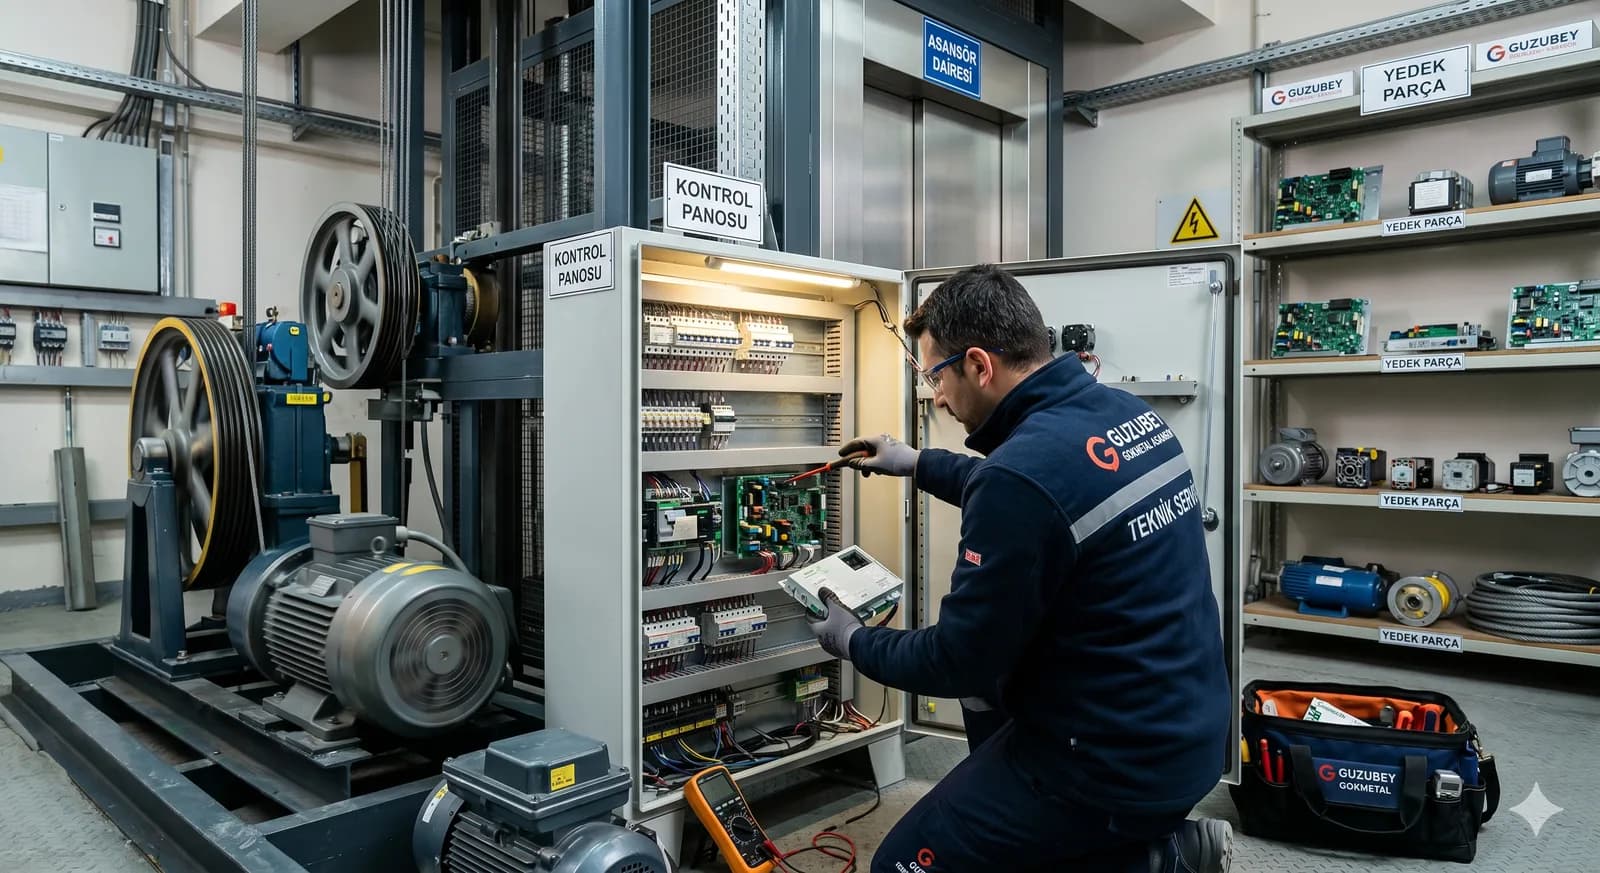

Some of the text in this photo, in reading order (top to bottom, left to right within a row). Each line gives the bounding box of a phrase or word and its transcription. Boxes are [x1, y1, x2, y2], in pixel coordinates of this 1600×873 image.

[928, 34, 977, 66] ASANSÖR
[1508, 29, 1580, 53] GUZUBEY
[933, 56, 972, 84] DAİRESİ
[1383, 58, 1446, 83] YEDEK
[1288, 78, 1344, 98] GUZUBEY
[1383, 79, 1446, 102] PARÇA
[676, 177, 754, 209] KONTROL
[683, 203, 747, 230] PANOSU
[1386, 215, 1462, 232] YEDEK PARÇA
[554, 243, 607, 268] KONTROL
[559, 265, 602, 287] PANOSU
[1385, 356, 1461, 369] YEDEK PARÇA
[1383, 495, 1460, 510] YEDEK PARÇA
[1127, 497, 1177, 542] TEKNİK
[1382, 630, 1460, 649] YEDEK PARÇA
[1338, 767, 1397, 784] GUZUBEY
[1339, 782, 1392, 795] GOKMETAL
